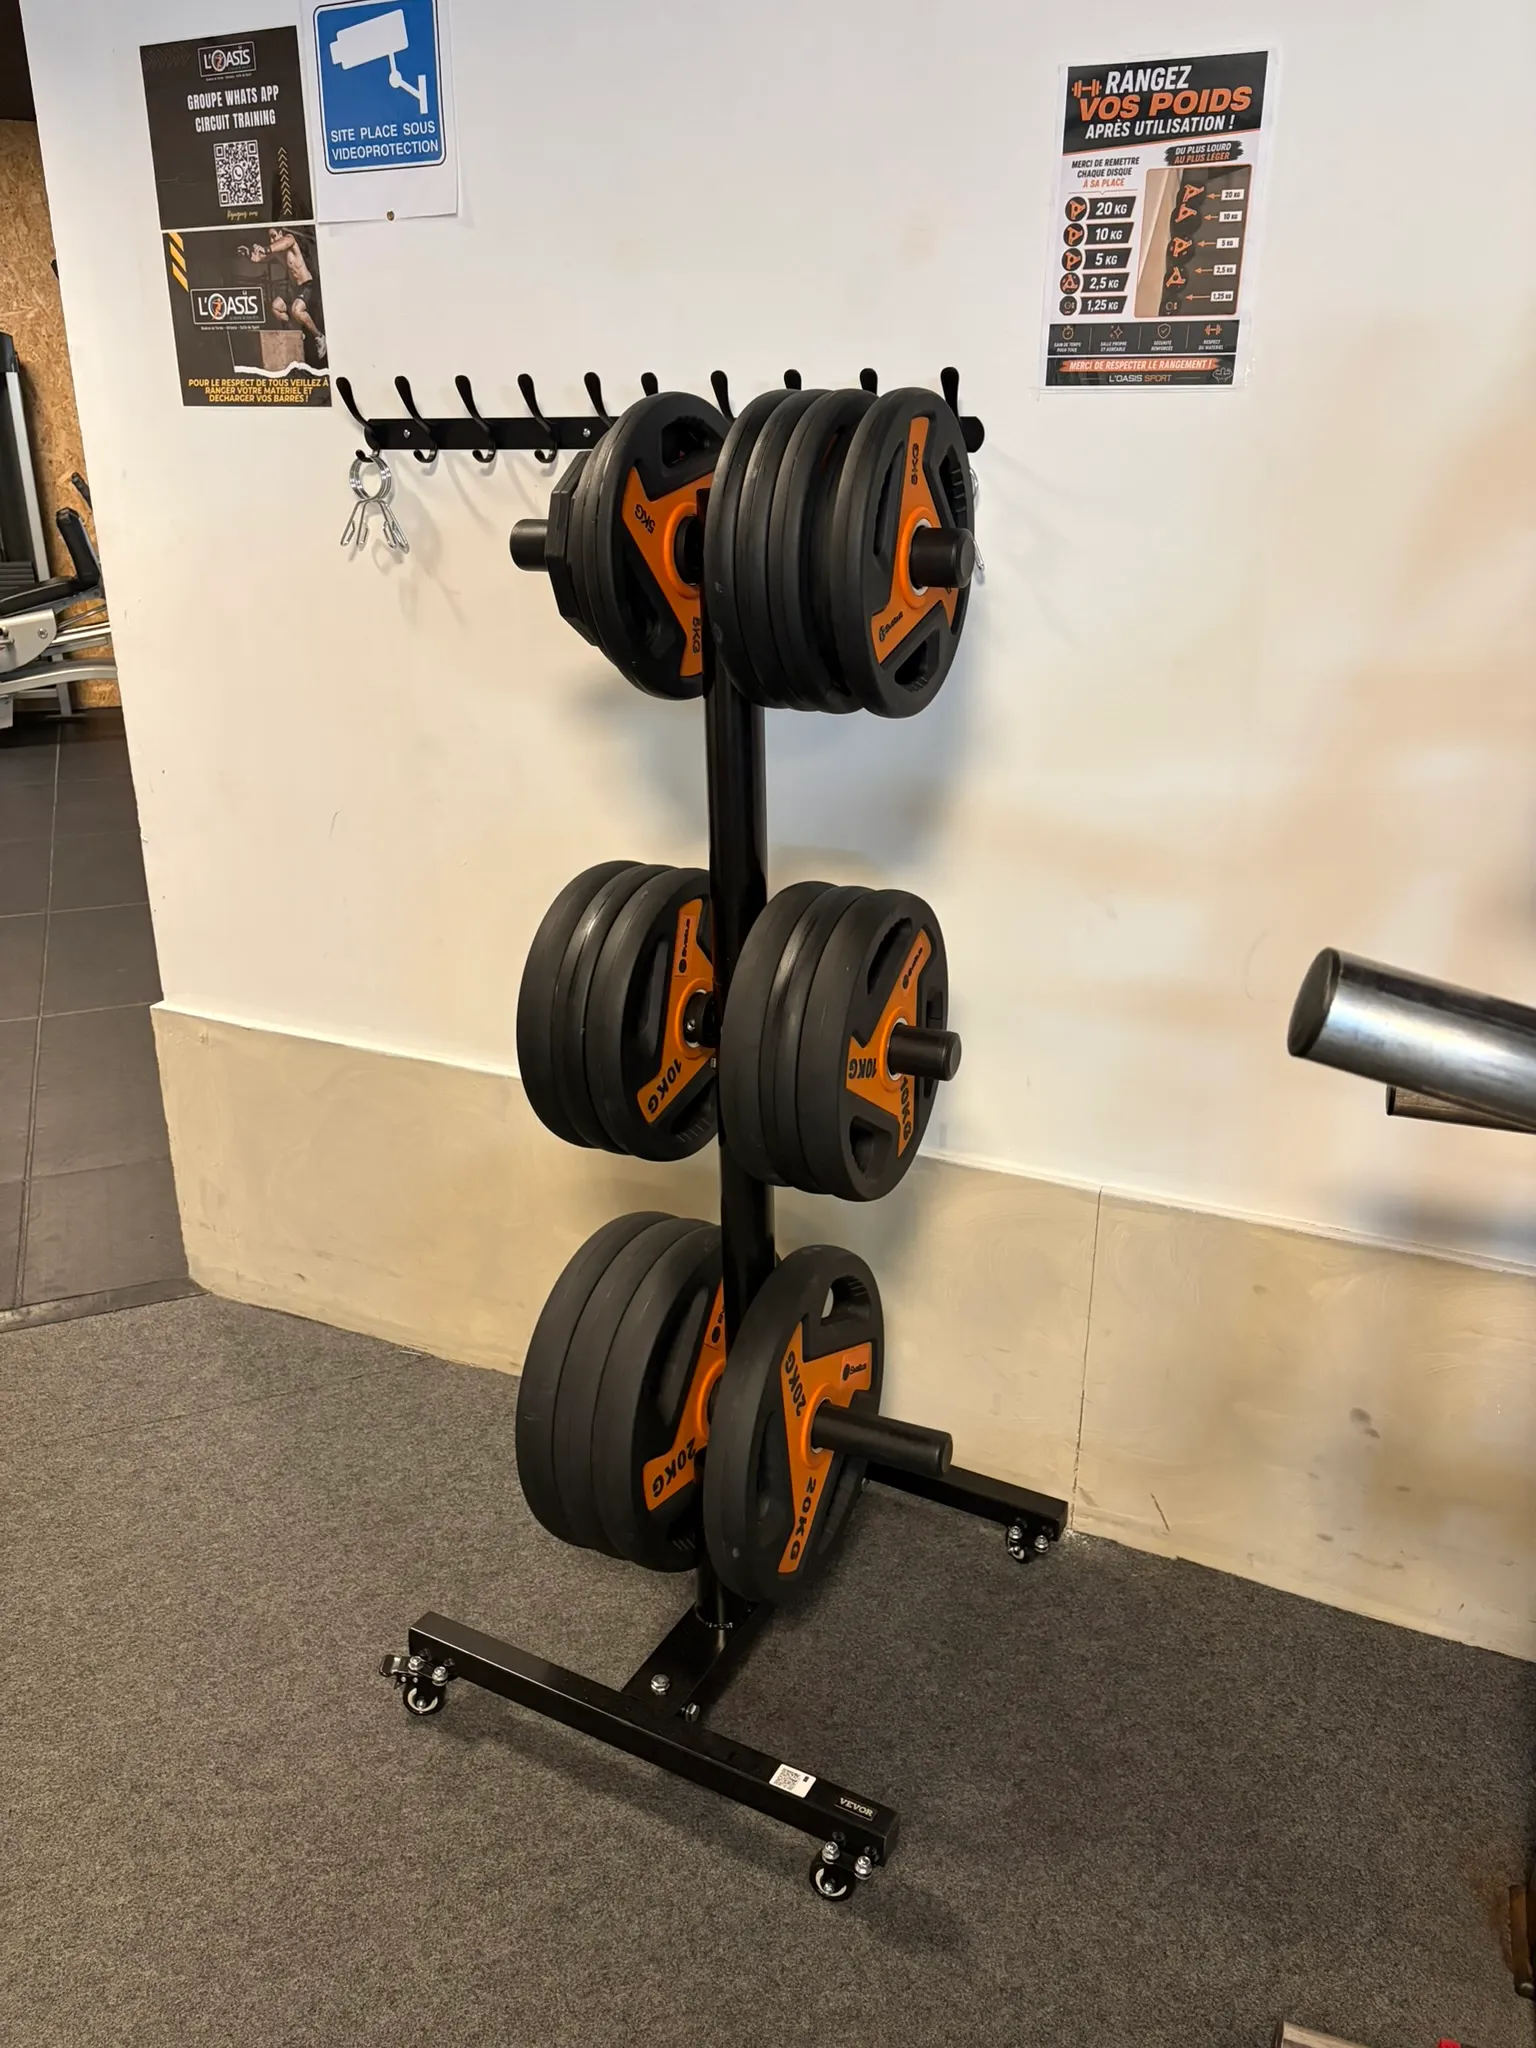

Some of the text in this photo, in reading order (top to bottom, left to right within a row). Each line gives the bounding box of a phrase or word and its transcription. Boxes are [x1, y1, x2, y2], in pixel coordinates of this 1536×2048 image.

[1105, 64, 1192, 95] RANGEZ
[187, 85, 279, 110] GROUPE WHATS APP
[1079, 86, 1253, 121] VOS POIDS
[195, 109, 276, 133] CIRCUIT TRAINING
[1085, 114, 1236, 139] APRÈS UTILISATION !
[331, 121, 436, 143] SITE PLACE SOUS
[331, 139, 439, 161] VIDEOPROTECTION
[1174, 155, 1185, 164] AU
[1186, 154, 1205, 163] PLUS
[1175, 143, 1232, 155] DU PLUS LOURD
[1071, 156, 1140, 169] MERCI DE REMETTRE
[1077, 167, 1132, 179] CHAQUE DISQUE
[1090, 179, 1101, 187] SA
[1101, 177, 1125, 187] PLACE
[1095, 202, 1127, 215] 20 KG
[1095, 227, 1123, 240] 10 KG
[1095, 253, 1117, 265] 5 KG
[1089, 277, 1119, 290] 2,5 KG
[198, 290, 258, 320] L'OASIS
[1087, 299, 1119, 312] 1,25 KG
[1069, 361, 1093, 370] MERCI
[1094, 361, 1104, 370] DE
[1105, 360, 1147, 370] RESPECTER
[1148, 360, 1156, 369] LE
[1159, 359, 1206, 369] RANGEMENT
[188, 379, 209, 387] POUR
[211, 379, 220, 387] LE
[221, 379, 255, 387] RESPECT
[256, 379, 266, 387] DE
[269, 378, 289, 387] TOUS
[290, 378, 321, 387] VEILLEZ
[1109, 374, 1172, 382] L'OASIS SPORT
[205, 387, 236, 395] RANGER
[237, 387, 262, 395] VOTRE
[257, 394, 272, 402] VOS
[273, 394, 304, 402] BARRES
[634, 503, 656, 534] 5KG
[848, 1057, 877, 1080] 10KG
[647, 1058, 682, 1114] 10KG
[900, 1077, 912, 1141] 10KG
[784, 1350, 806, 1417] 20KG
[652, 1437, 698, 1498] 20KG
[789, 1475, 817, 1561] 20KG
[839, 1797, 874, 1817] VEVOR
